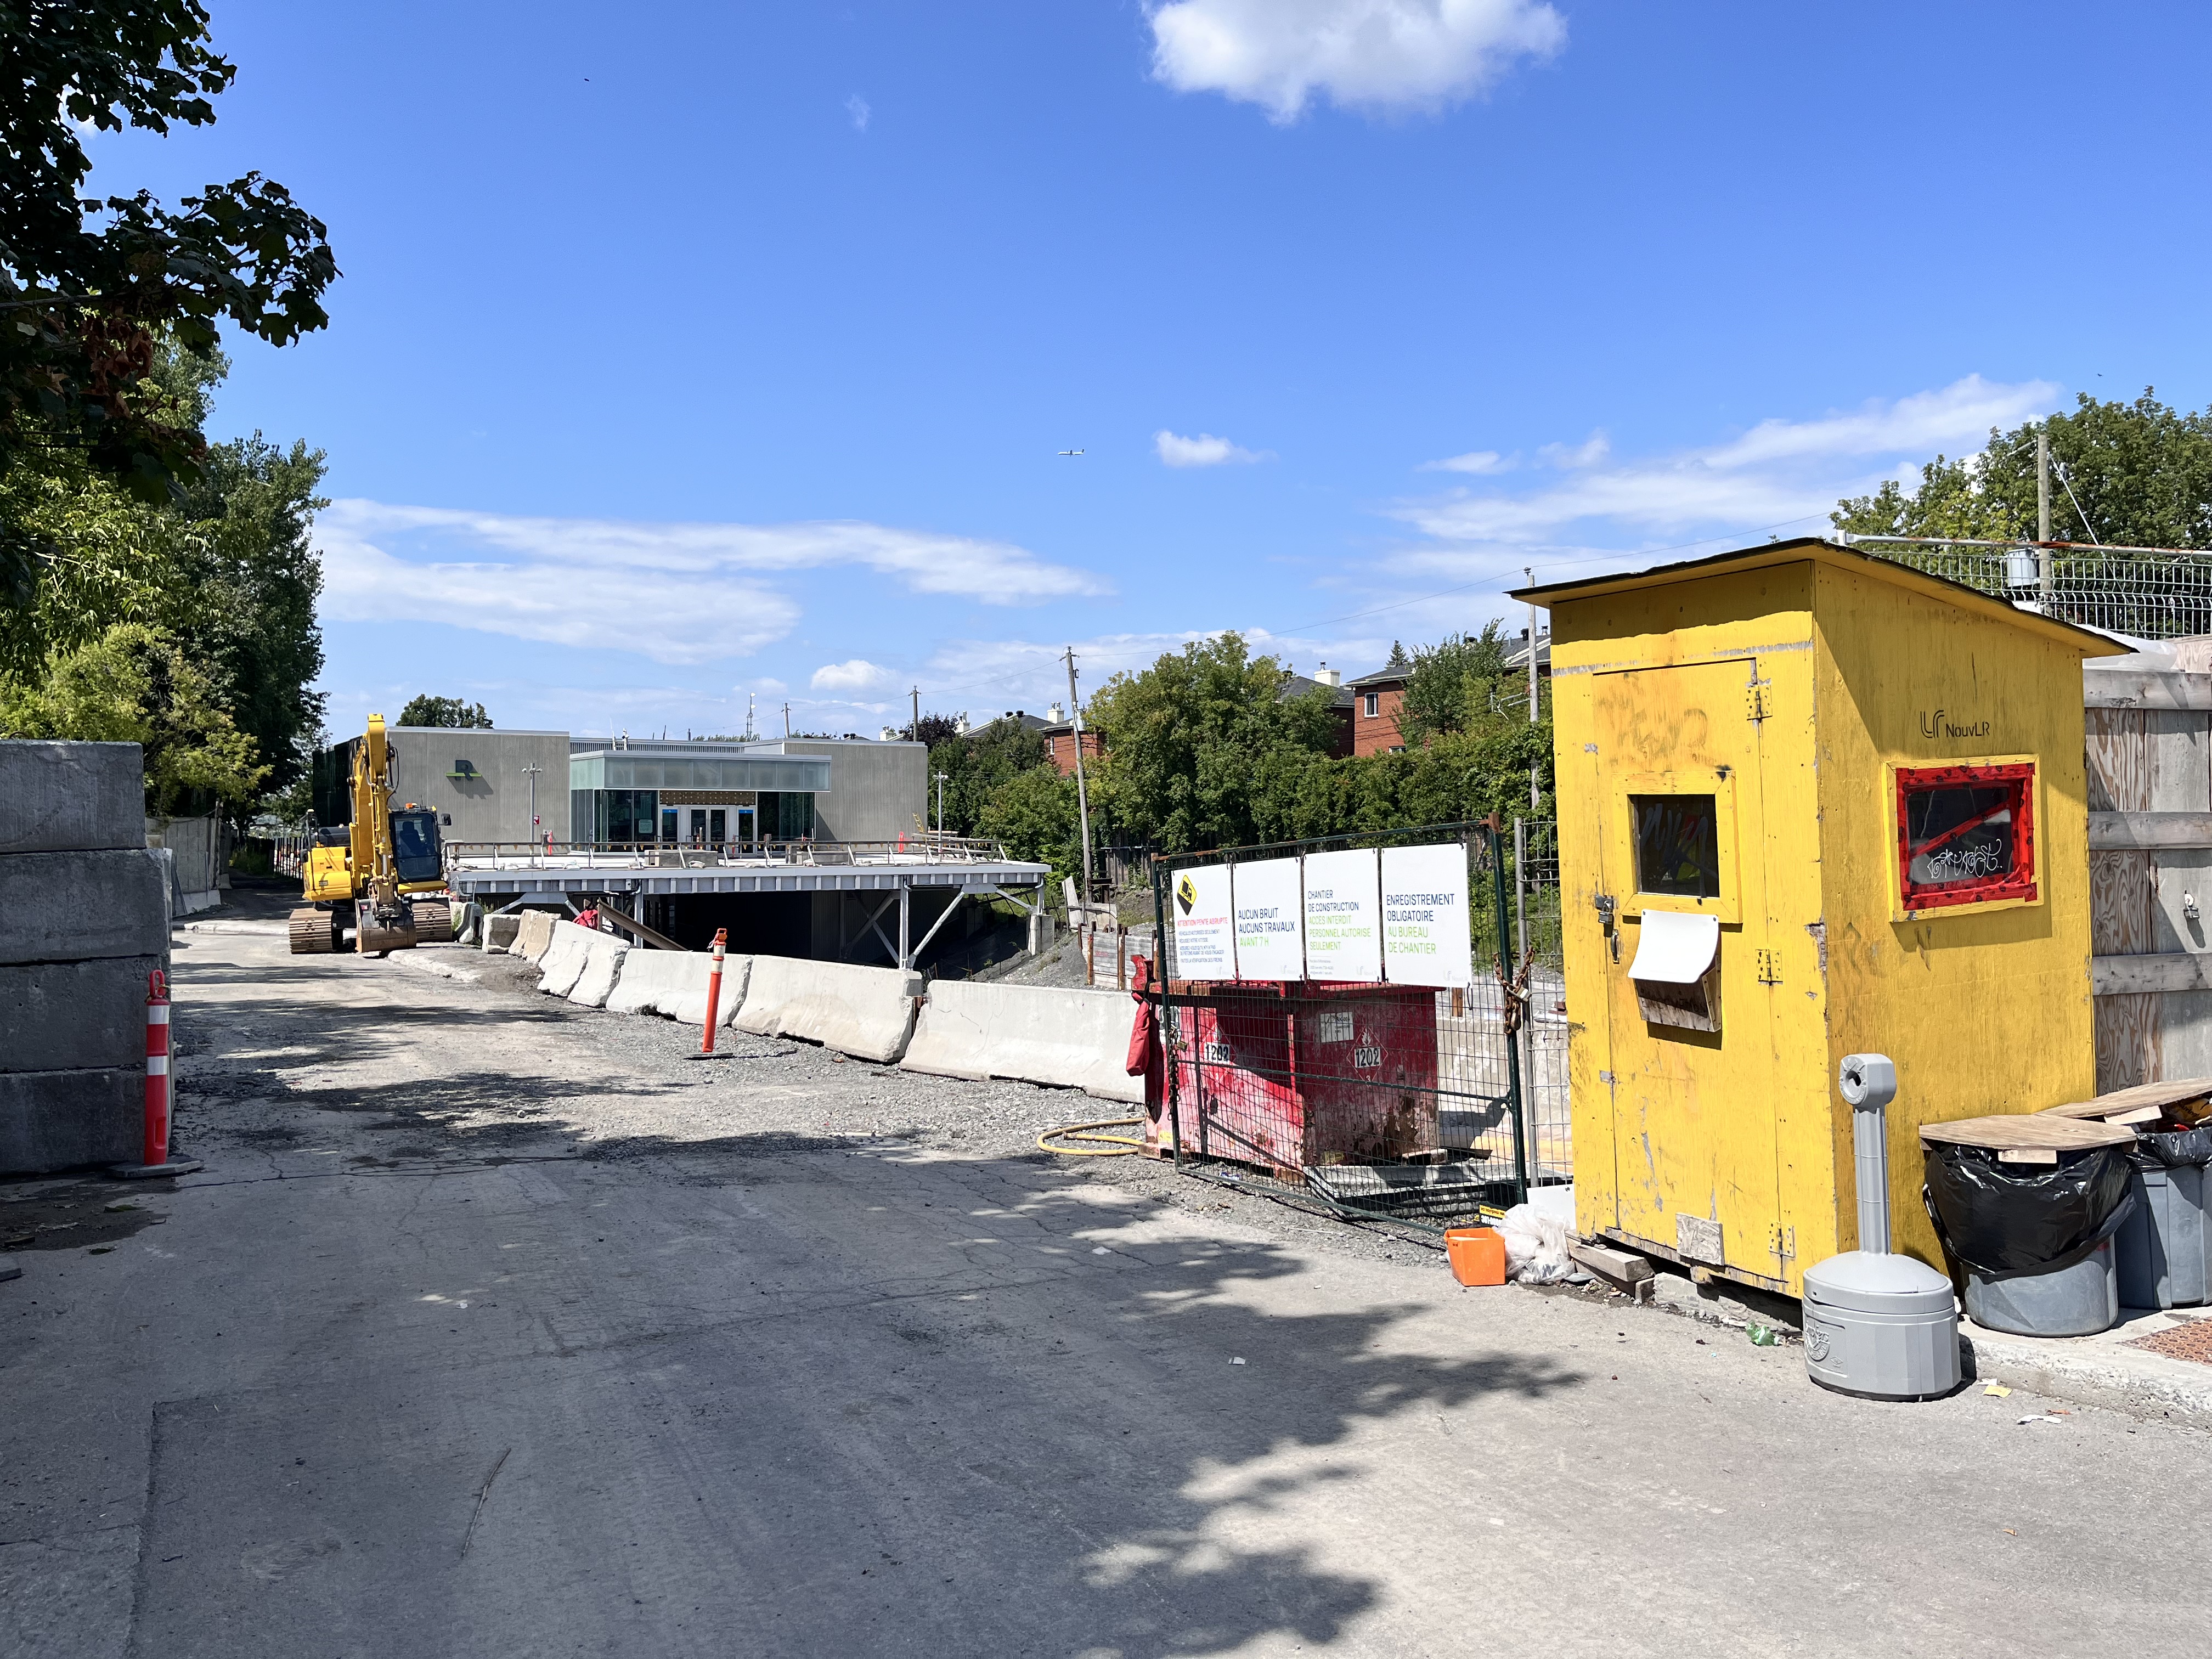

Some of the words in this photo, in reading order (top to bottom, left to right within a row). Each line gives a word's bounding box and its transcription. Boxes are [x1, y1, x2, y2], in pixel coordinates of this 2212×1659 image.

[1946, 721, 1990, 738] NouvLR
[1308, 890, 1333, 899] CHANTIER
[1386, 894, 1454, 905] ENREGISTREMENT
[1308, 904, 1314, 912] DE
[1316, 902, 1359, 912] CONSTRUCTION
[1238, 909, 1259, 919] AUCUN
[1260, 908, 1278, 918] BRUIT
[1387, 910, 1434, 921] OBLIGATOIRE
[1309, 915, 1325, 924] ACCÈS
[1327, 915, 1351, 924] INTERDIT
[1239, 923, 1263, 933] AUCUNS
[1264, 921, 1295, 933] TRAVAUX
[1309, 928, 1340, 938] PERSONNEL
[1341, 926, 1371, 937] AUTORISÉ
[1388, 926, 1396, 936] AU
[1398, 927, 1428, 938] BUREAU
[1240, 937, 1258, 946] AVANT
[1260, 936, 1263, 946] 7
[1265, 936, 1269, 946] H
[1310, 941, 1341, 950] SEULEMENT
[1389, 942, 1397, 952] DE
[1399, 942, 1436, 954] CHANTIER
[1205, 1044, 1229, 1062] 1202
[1356, 1047, 1379, 1067] 1202
